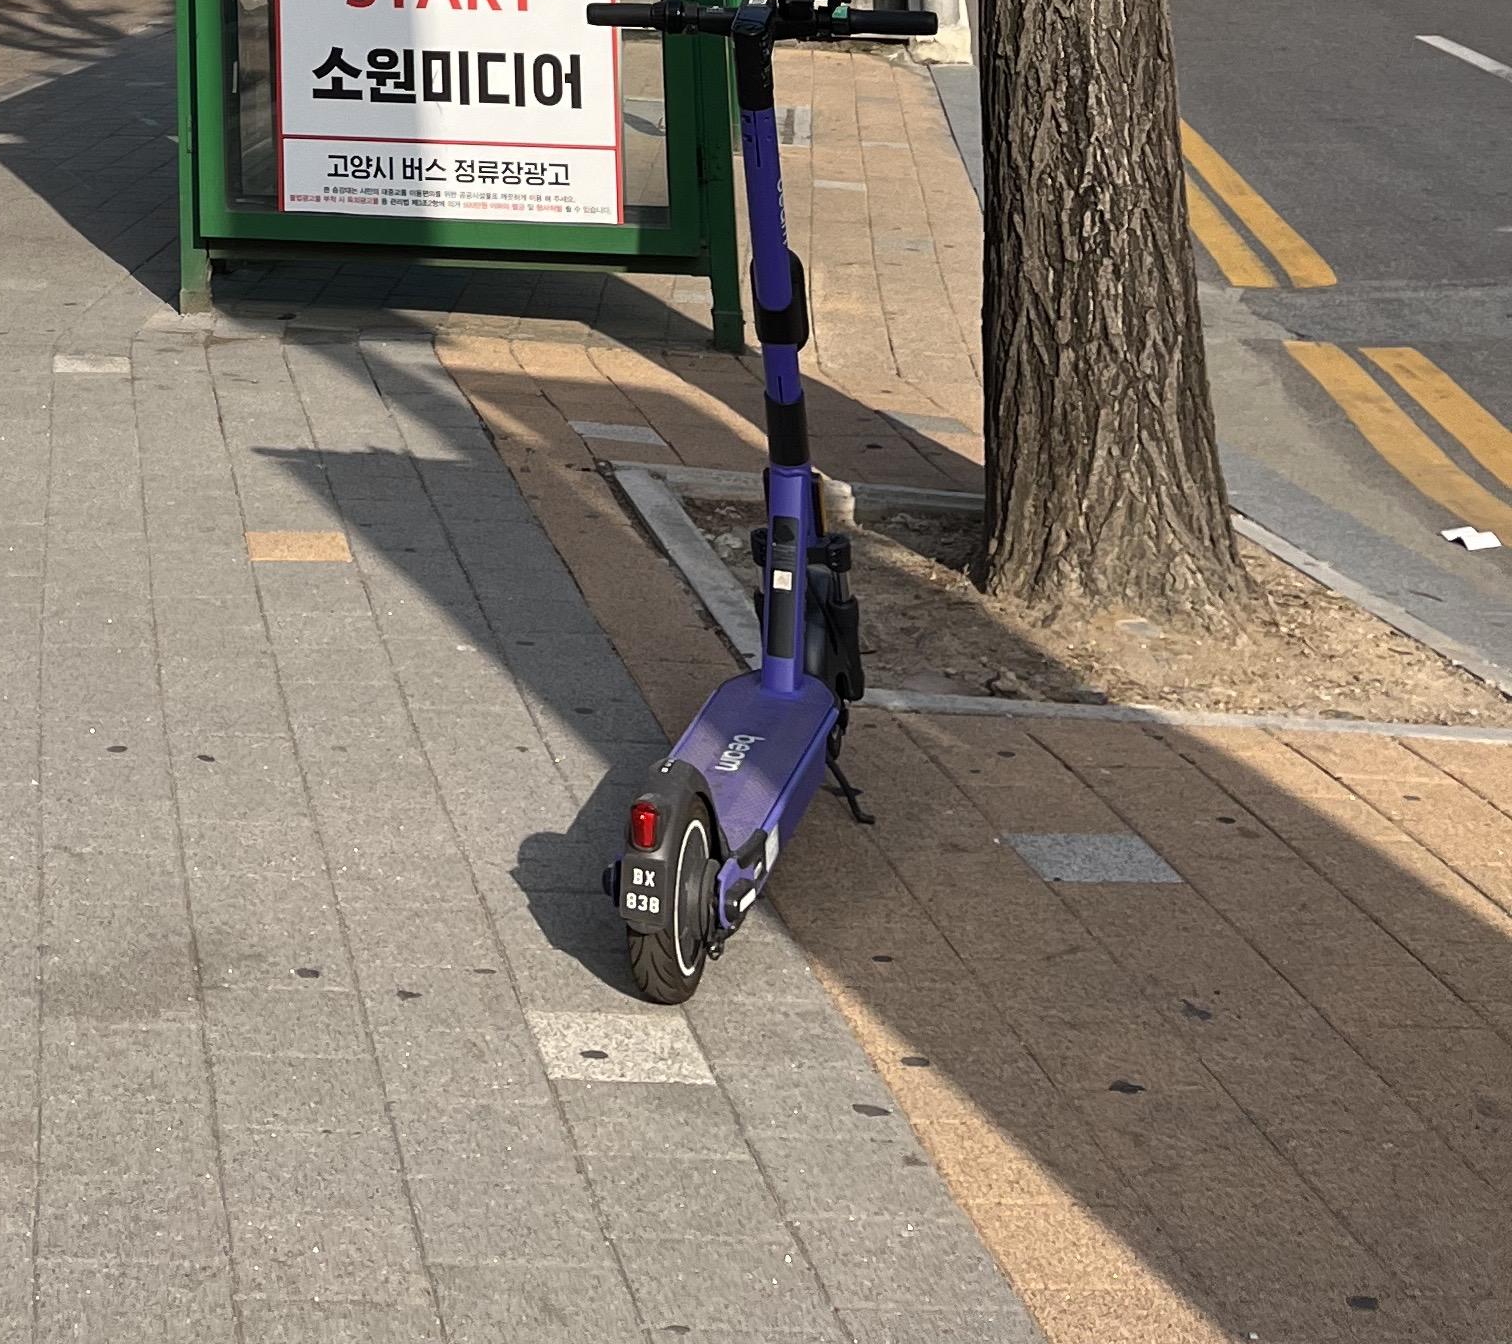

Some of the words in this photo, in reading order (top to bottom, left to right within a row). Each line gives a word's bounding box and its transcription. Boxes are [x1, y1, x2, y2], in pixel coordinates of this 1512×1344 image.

[311, 45, 583, 110] 소원미디어
[327, 154, 395, 180] 고양시
[402, 157, 447, 181] 버스
[454, 158, 571, 186] 정류장광고
[715, 734, 766, 772] beam
[632, 867, 657, 888] BX
